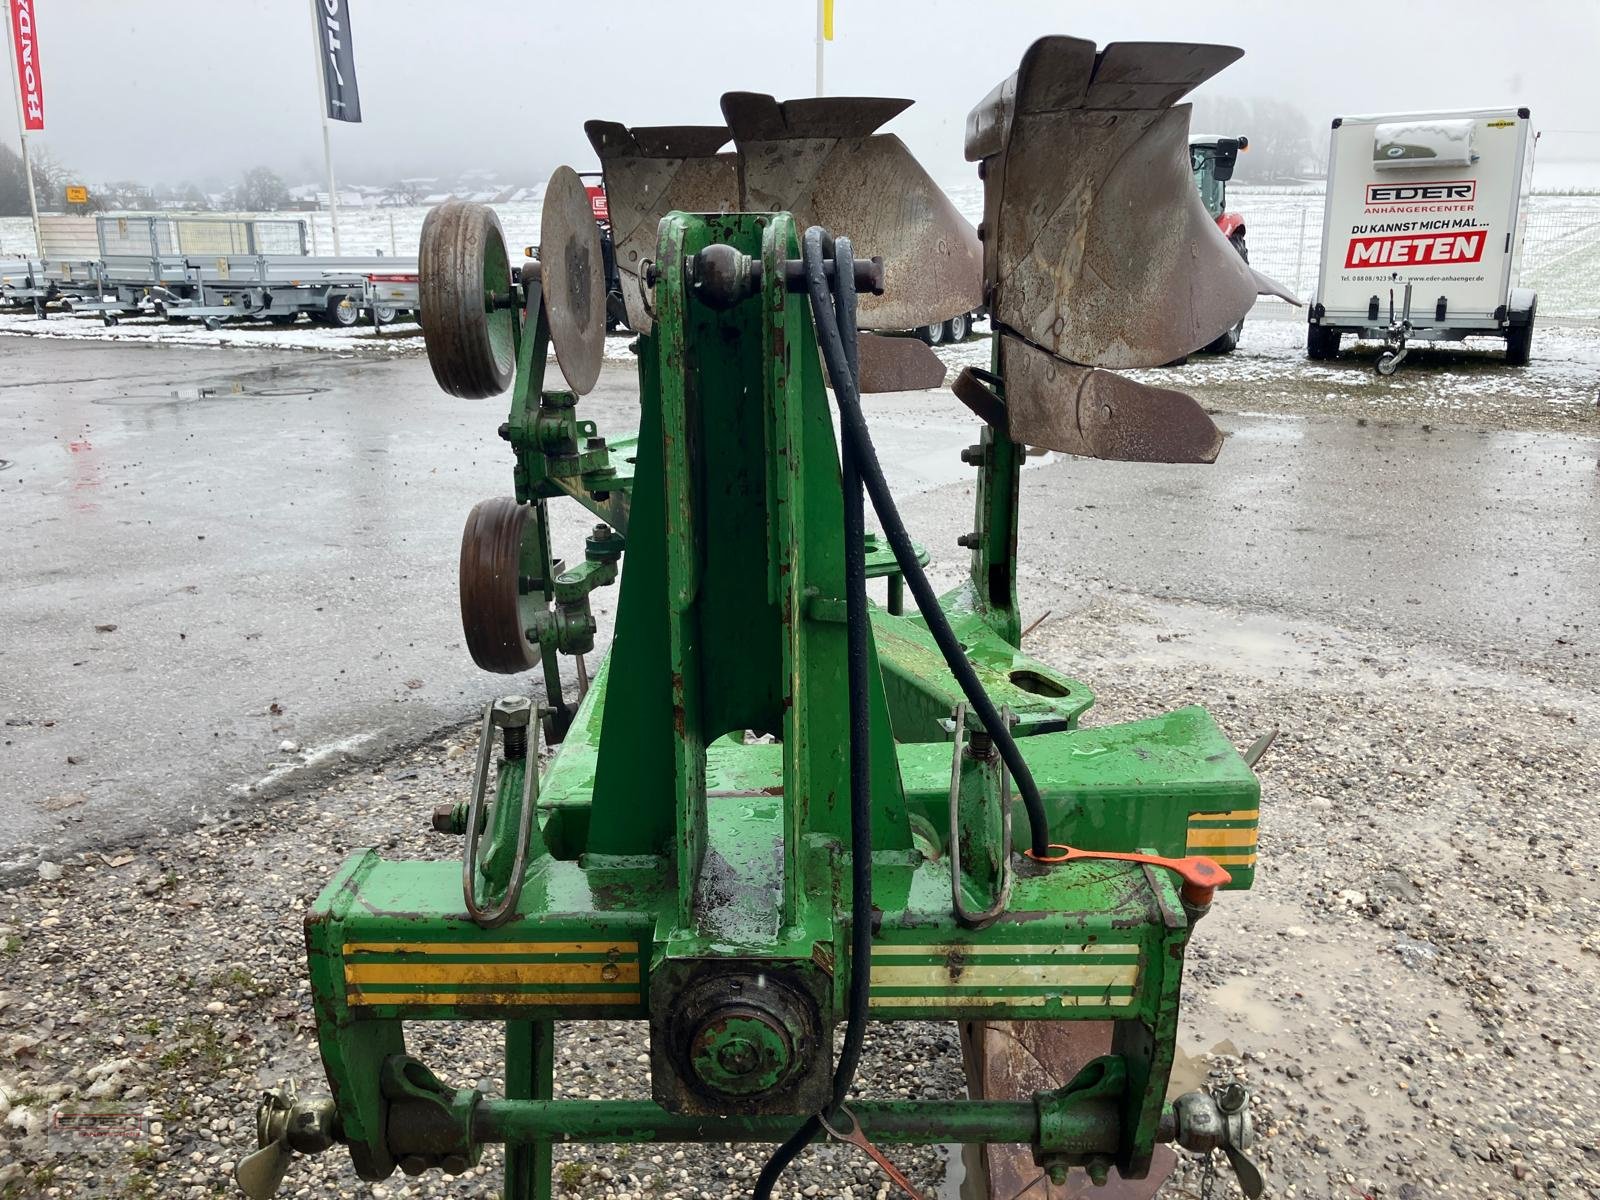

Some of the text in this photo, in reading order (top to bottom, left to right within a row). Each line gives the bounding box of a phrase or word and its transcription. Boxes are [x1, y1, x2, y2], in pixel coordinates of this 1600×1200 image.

[1371, 185, 1472, 201] EDER
[1364, 205, 1474, 214] ANHÄNGERCENTER
[1351, 225, 1368, 234] DU
[1369, 222, 1419, 233] KANNST
[1420, 220, 1450, 230] MICH
[1452, 218, 1477, 228] MAL
[1351, 235, 1479, 265] MIETEN
